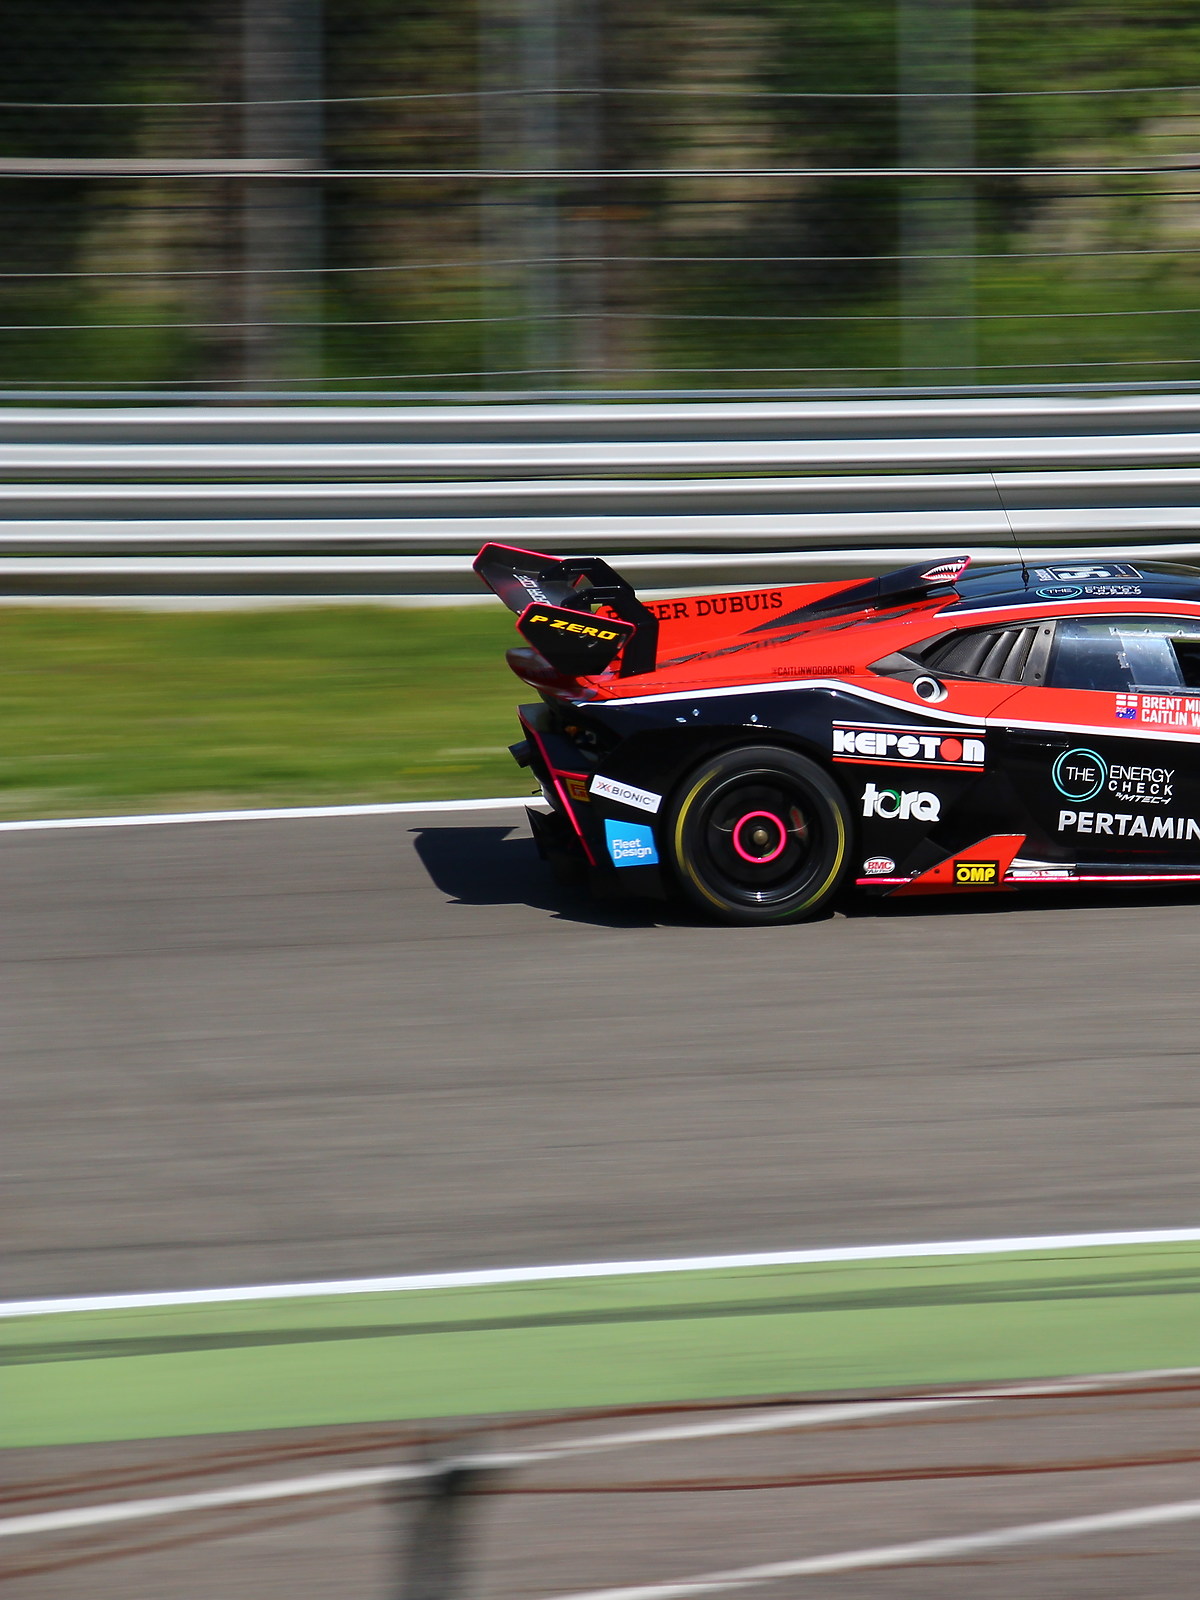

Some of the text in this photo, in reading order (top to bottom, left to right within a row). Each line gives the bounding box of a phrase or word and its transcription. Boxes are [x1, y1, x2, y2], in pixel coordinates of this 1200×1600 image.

[695, 592, 783, 617] DUBUIS
[529, 614, 618, 640] P ZERO
[1142, 695, 1182, 710] BRENT
[1141, 708, 1188, 726] CAITLIN
[832, 729, 985, 762] KEPSTON
[1065, 764, 1175, 784] THE ENERGY
[1108, 779, 1174, 796] CHECK
[612, 838, 641, 850] Fleet
[613, 846, 652, 859] Design
[868, 861, 892, 870] BMC
[956, 867, 996, 882] OMP
